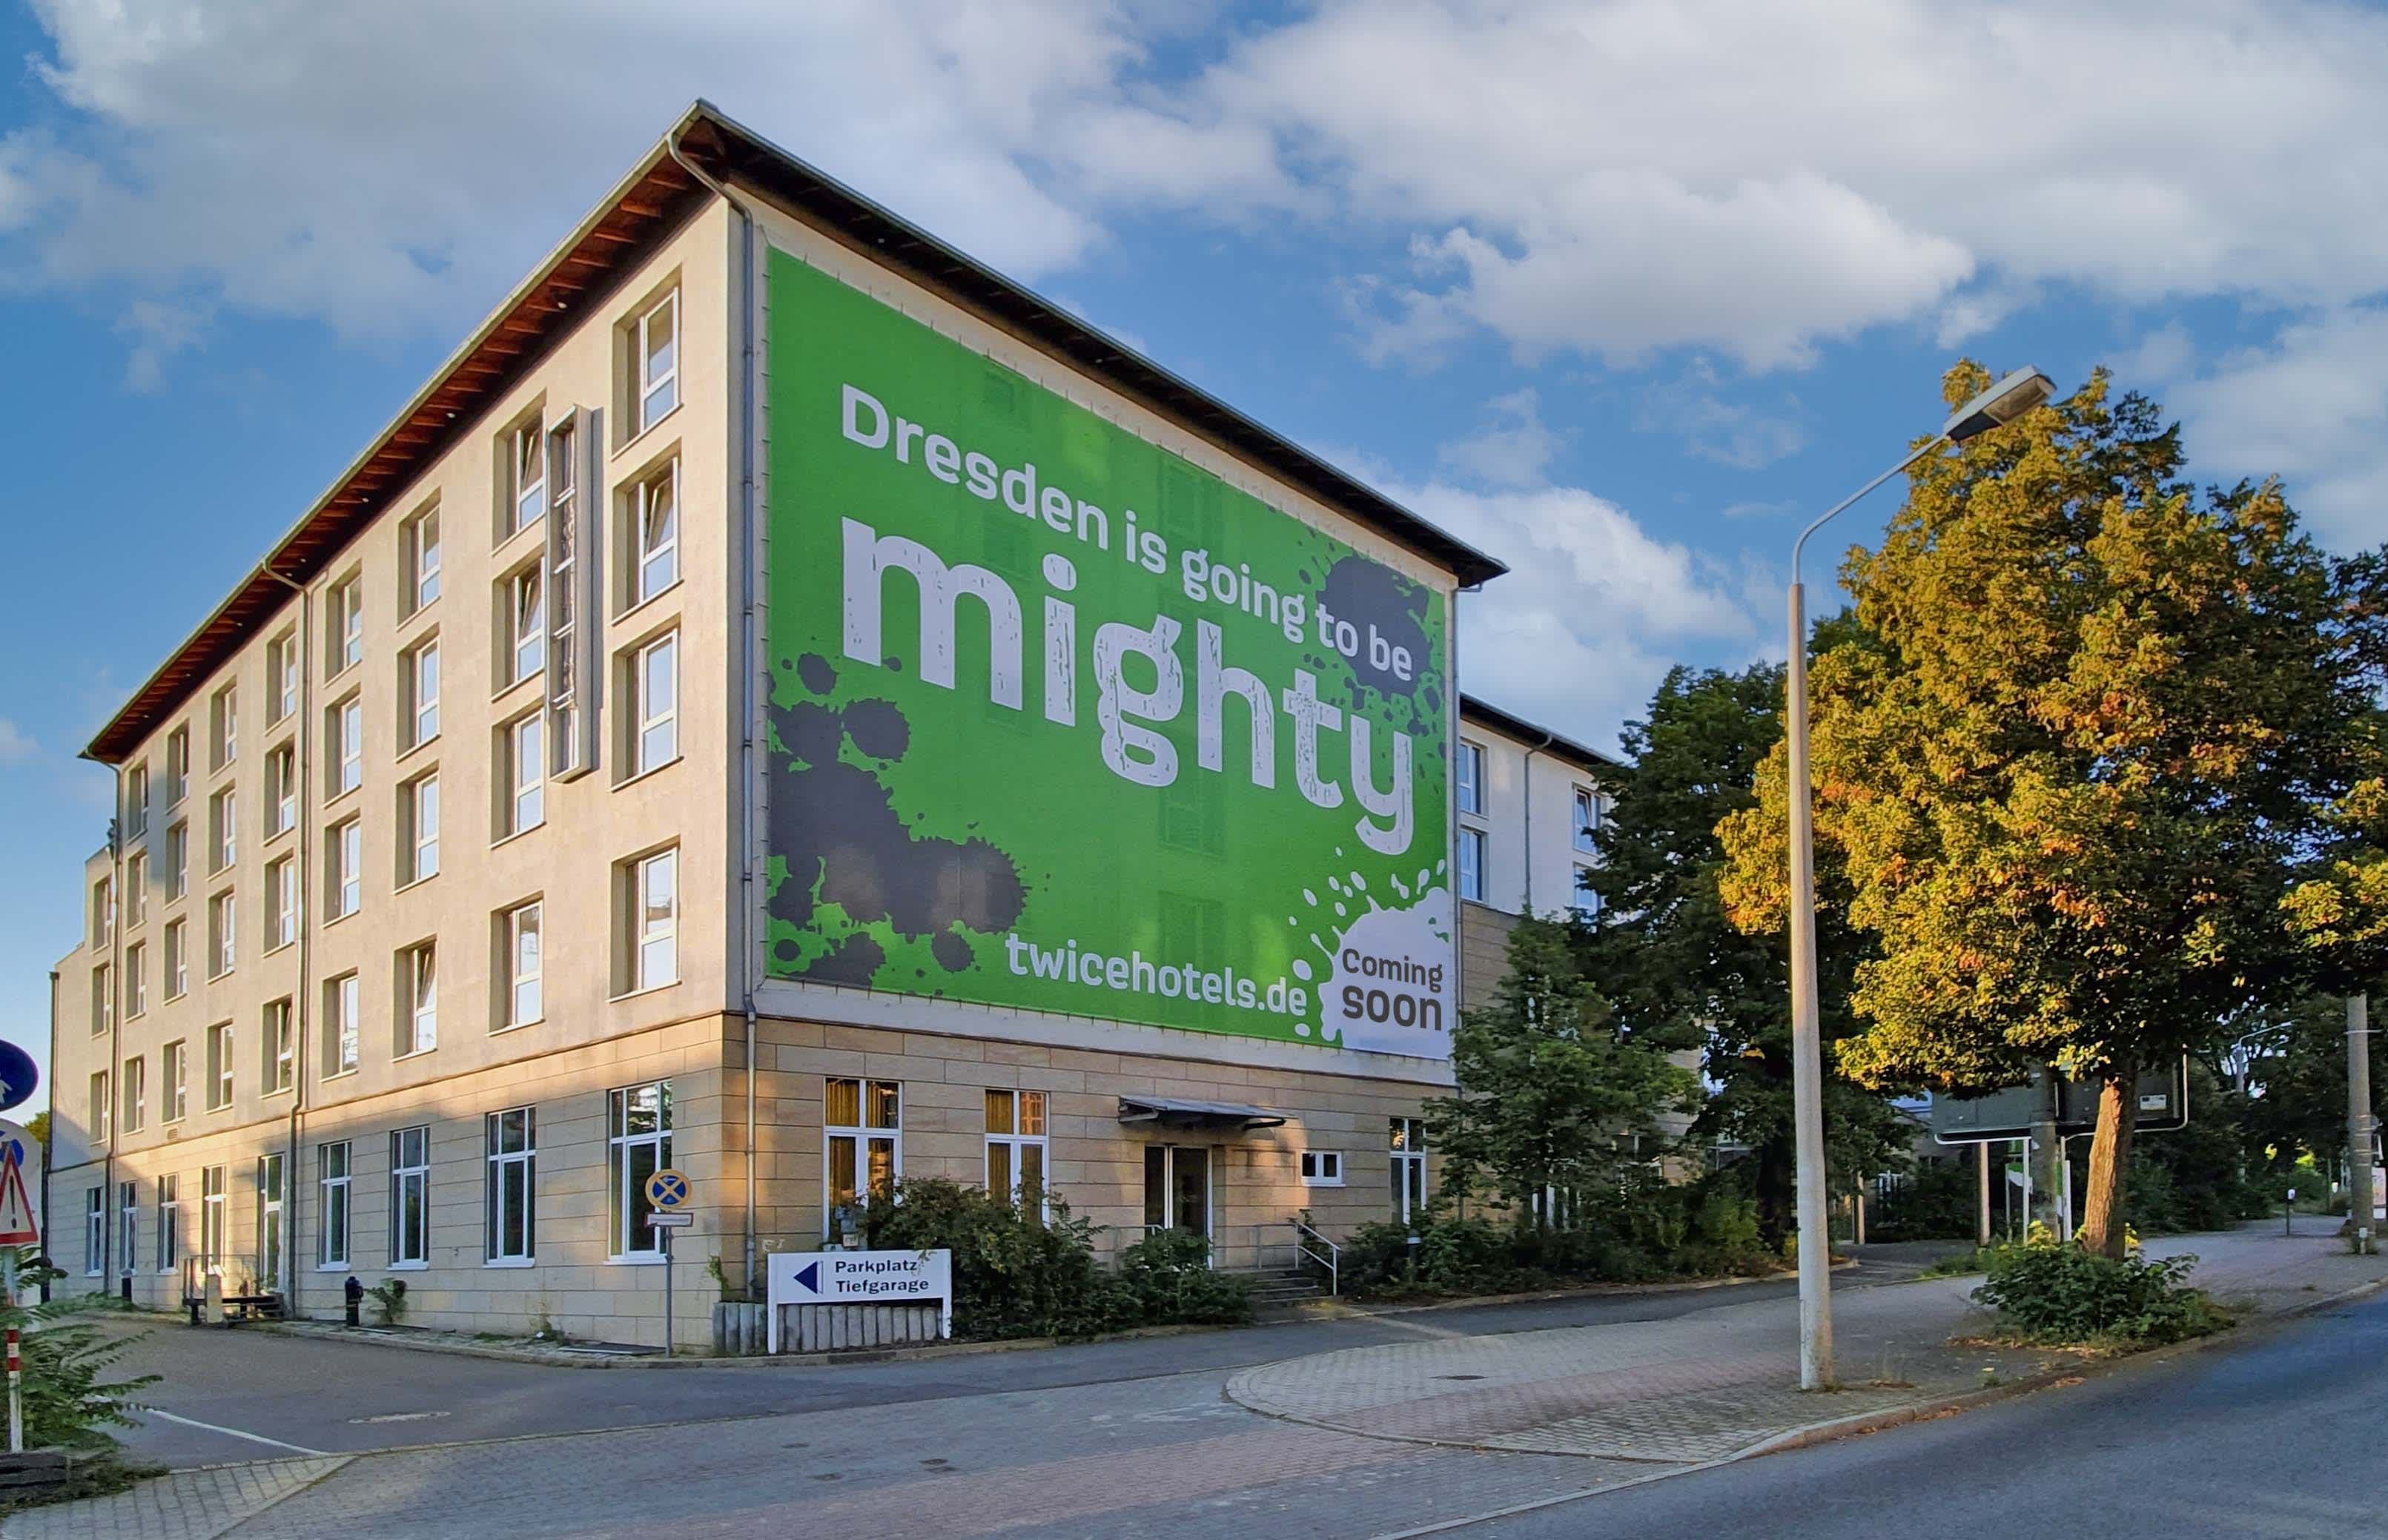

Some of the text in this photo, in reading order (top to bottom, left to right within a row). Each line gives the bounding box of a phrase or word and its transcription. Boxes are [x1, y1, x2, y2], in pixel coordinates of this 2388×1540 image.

[842, 383, 1412, 681] Dresden is going to be
[842, 516, 1413, 855] mighty
[1005, 933, 1307, 1017] twicehotels.de
[1342, 948, 1443, 993] Coming
[1342, 985, 1442, 1031] soon
[835, 1259, 918, 1275] Parkplatz
[836, 1279, 929, 1295] Tiefgarage
